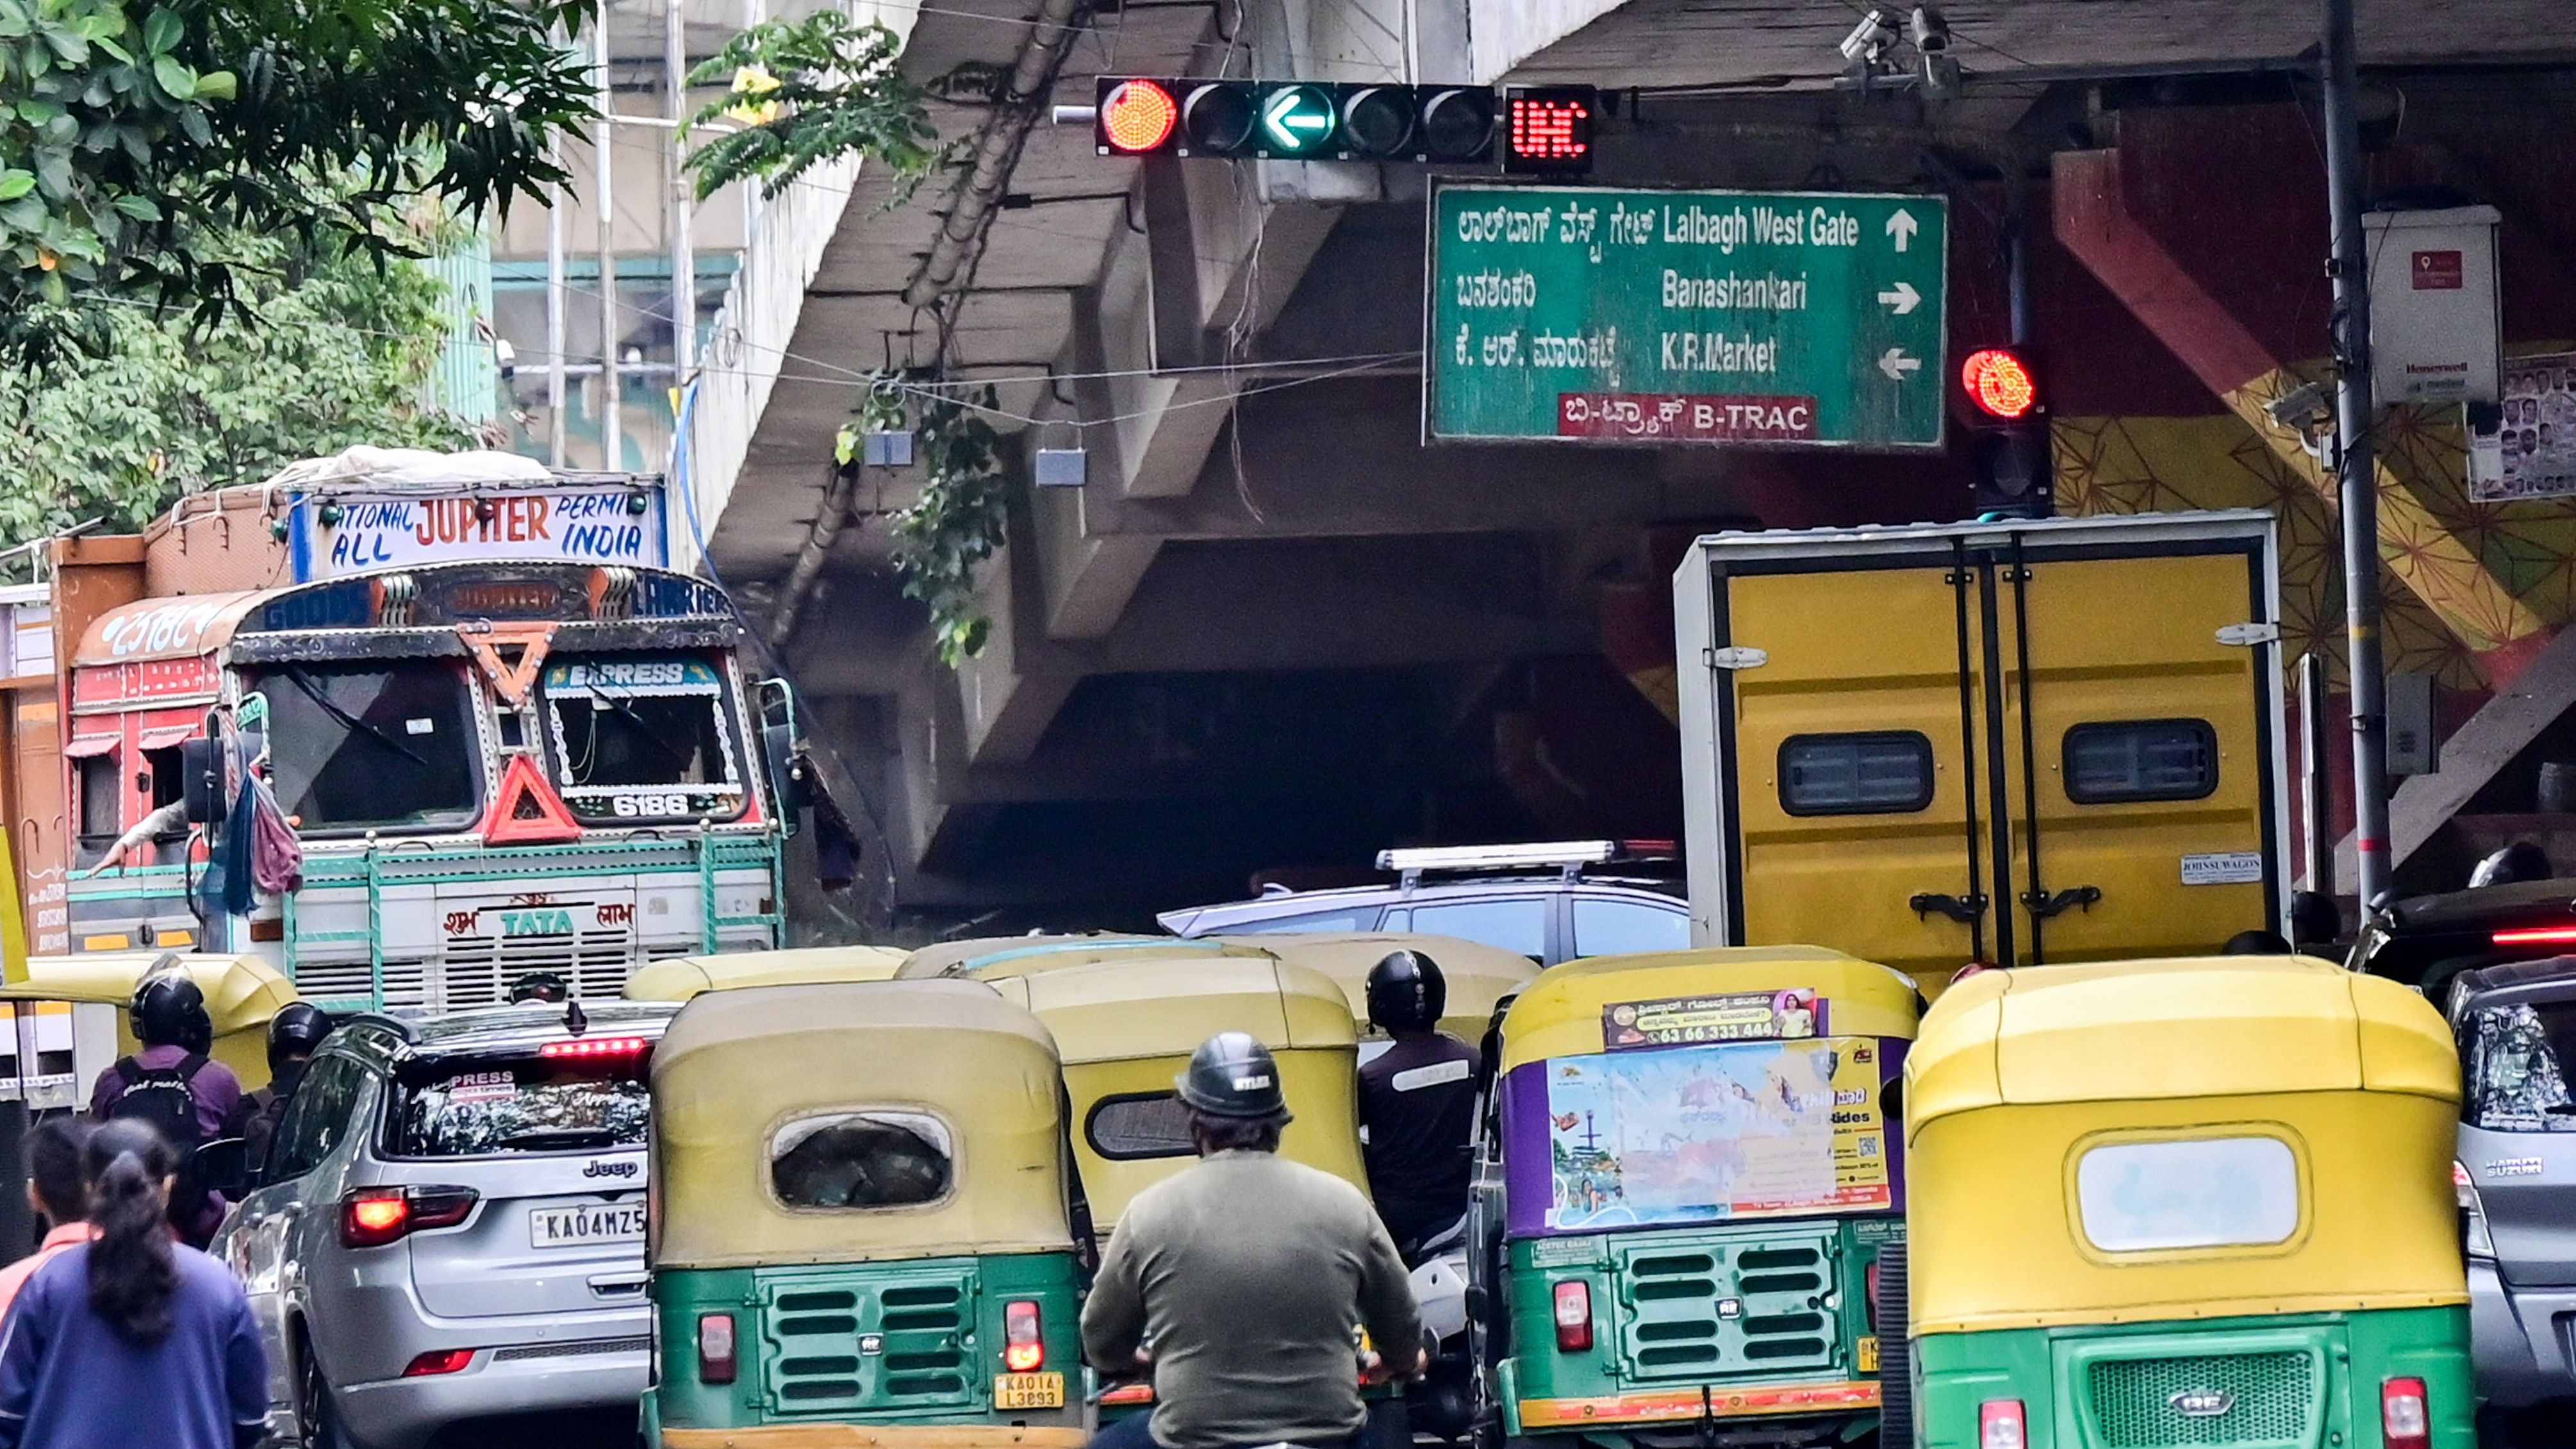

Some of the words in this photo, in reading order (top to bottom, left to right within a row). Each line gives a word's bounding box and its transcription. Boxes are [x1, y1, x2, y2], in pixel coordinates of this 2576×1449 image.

[1664, 205, 1747, 255] Lalbagh
[1753, 206, 1804, 246] West
[1810, 206, 1860, 247] Gate
[1457, 267, 1537, 308] ಬನಶಂಕರಿ
[1662, 269, 1806, 310] Banashankari
[1694, 404, 1809, 431] B-TRAC
[331, 533, 392, 568] ALL
[561, 523, 642, 561] INDIA
[569, 662, 684, 686] EXPRESS
[612, 794, 689, 816] 6186
[500, 910, 574, 935] TATA
[1660, 1028, 1680, 1043] 63
[1685, 1026, 1705, 1042] 66
[1710, 1025, 1738, 1040] 333
[1744, 1023, 1772, 1038] 444
[450, 1070, 514, 1088] PRESS
[582, 1159, 639, 1179] Jeep
[2486, 1165, 2543, 1178] SUZUKI
